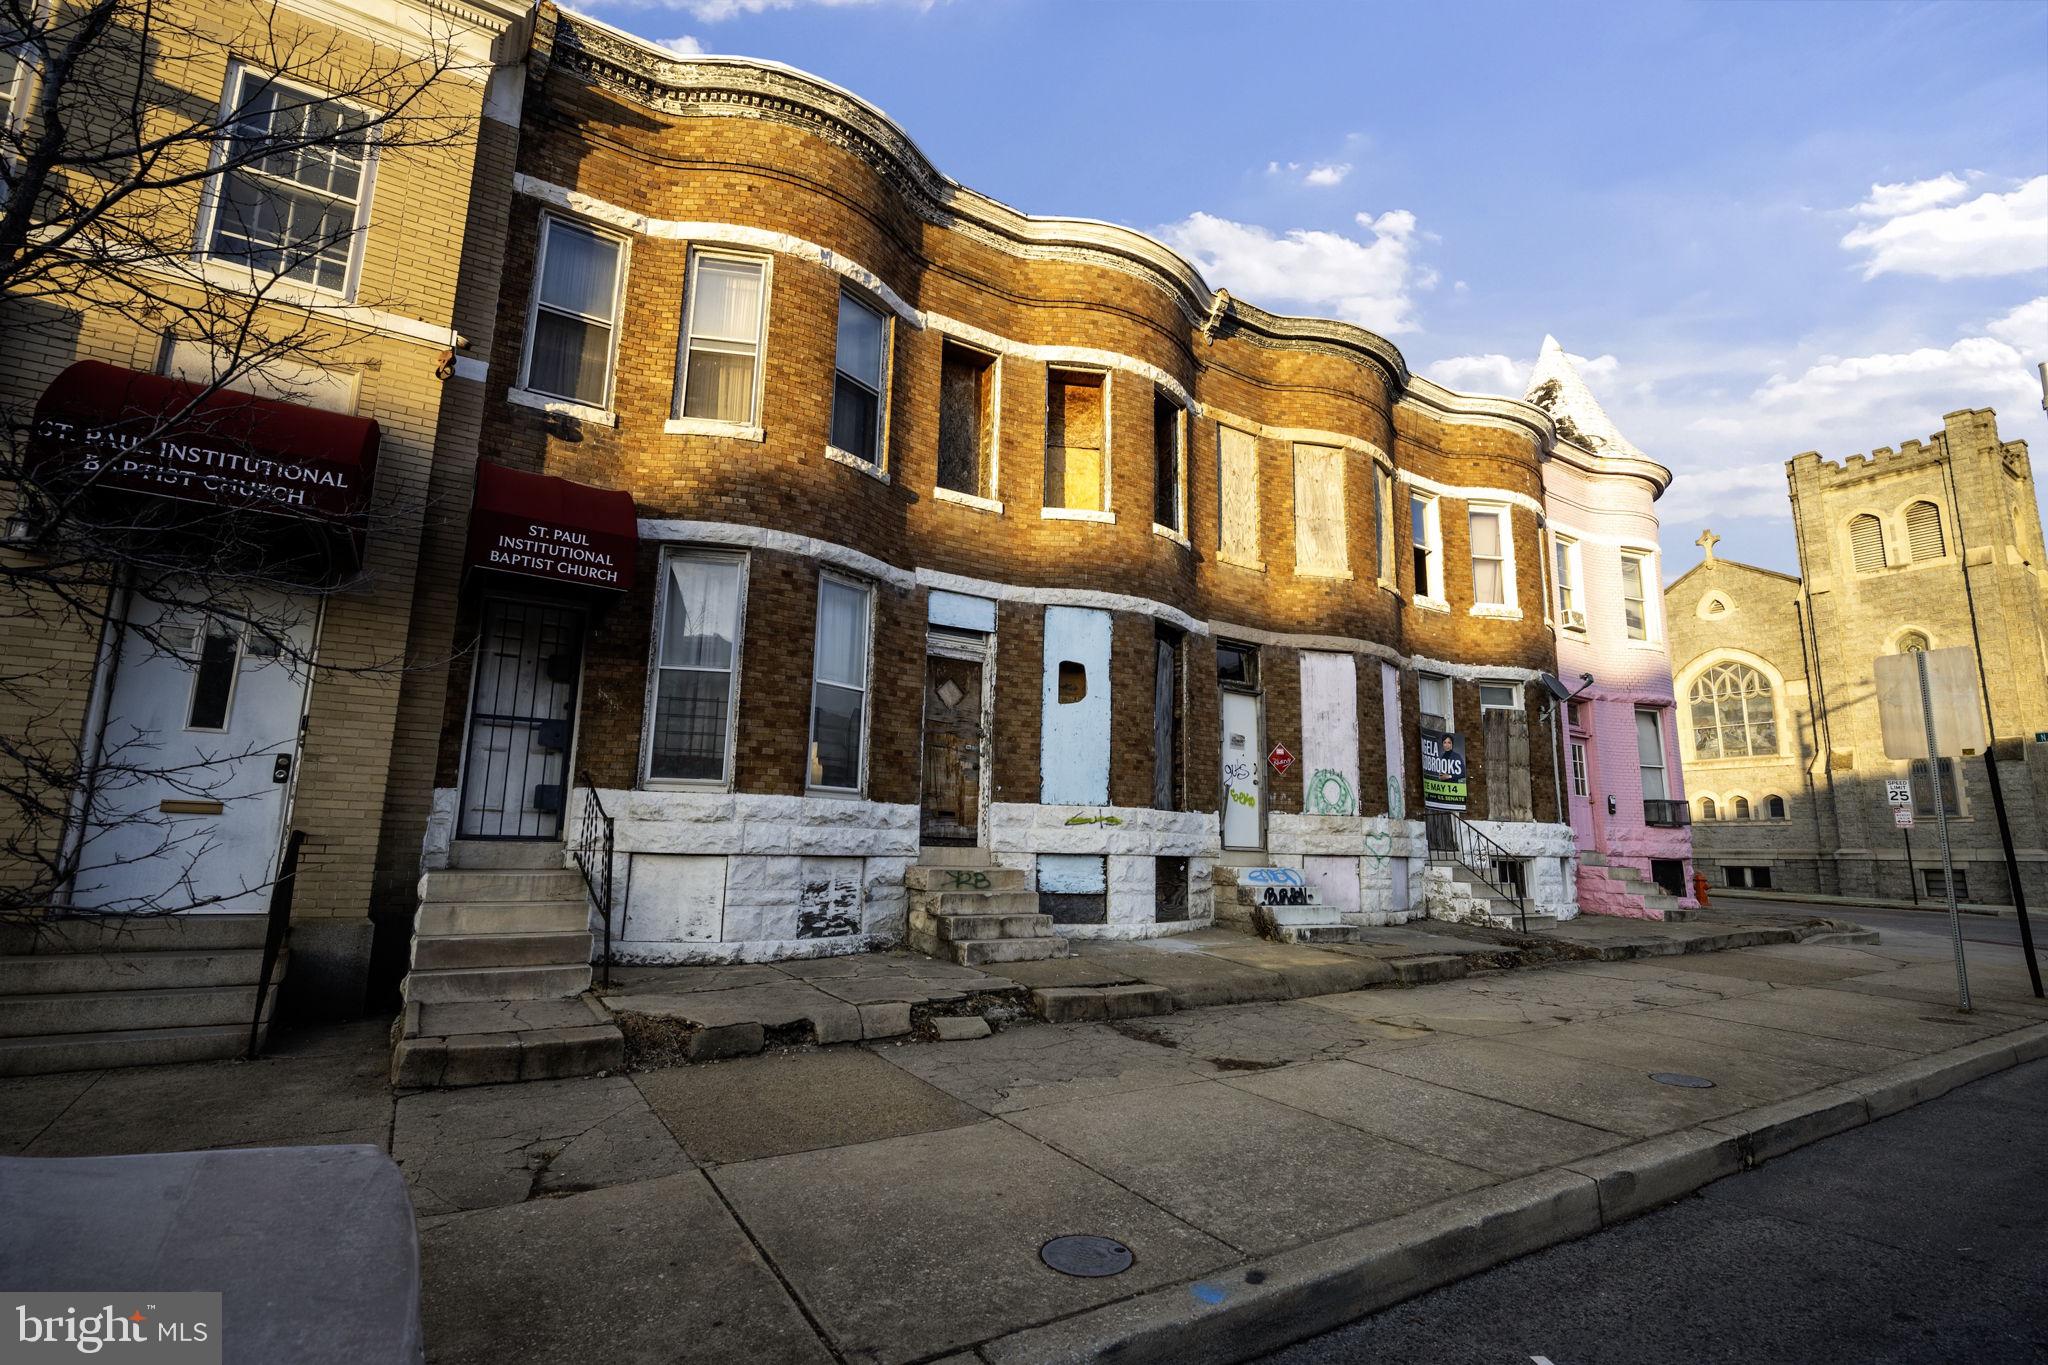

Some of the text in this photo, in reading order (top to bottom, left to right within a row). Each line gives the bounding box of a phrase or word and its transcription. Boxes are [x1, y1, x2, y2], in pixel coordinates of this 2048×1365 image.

[84, 453, 197, 487] BPTIST
[160, 441, 349, 489] INSTITUTIONAL
[498, 535, 614, 566] INSTITUTIONAL
[528, 525, 590, 546] ST. PAUL
[489, 550, 618, 582] BAPTIST CHURCH
[1430, 782, 1446, 792] MAY
[1447, 784, 1458, 793] 14
[1890, 790, 1909, 801] 25
